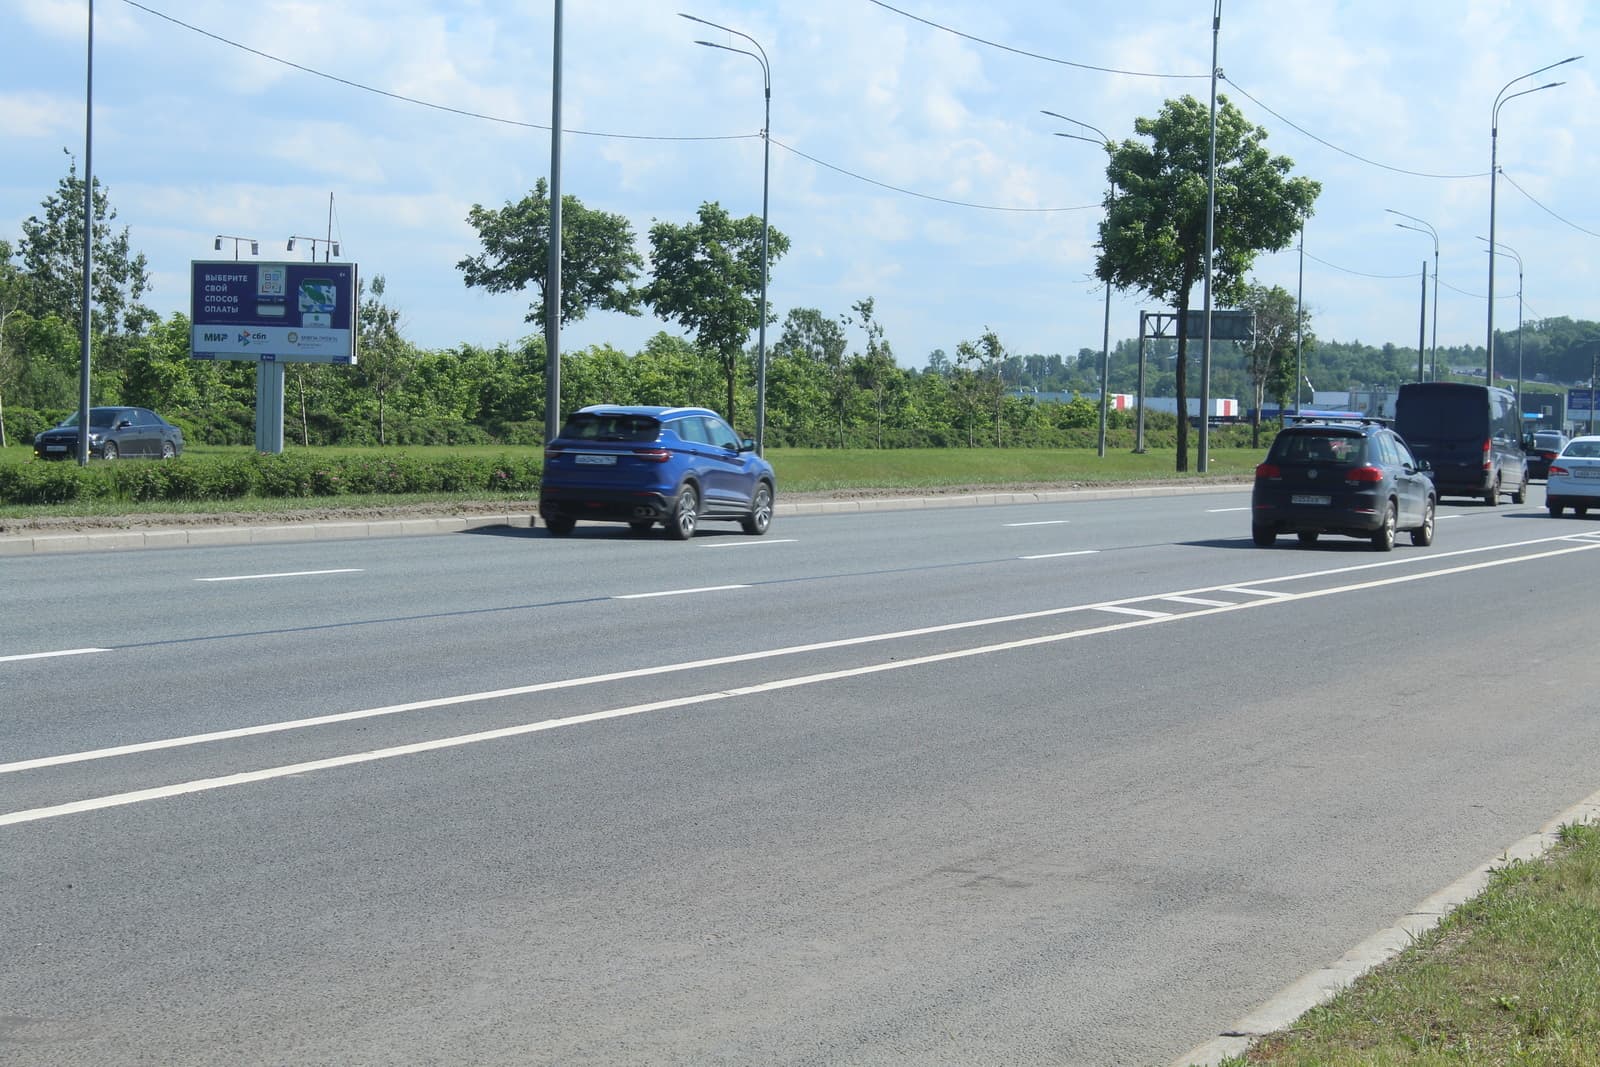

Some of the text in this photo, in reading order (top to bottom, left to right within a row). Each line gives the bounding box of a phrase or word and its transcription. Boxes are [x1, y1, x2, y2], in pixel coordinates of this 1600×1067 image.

[205, 274, 248, 282] ВЫБЕРИТЕ
[204, 283, 227, 292] СВОЙ
[204, 295, 239, 303] СПОСОБ
[204, 305, 239, 313] ОПЛАТЫ
[204, 332, 229, 342] МИР
